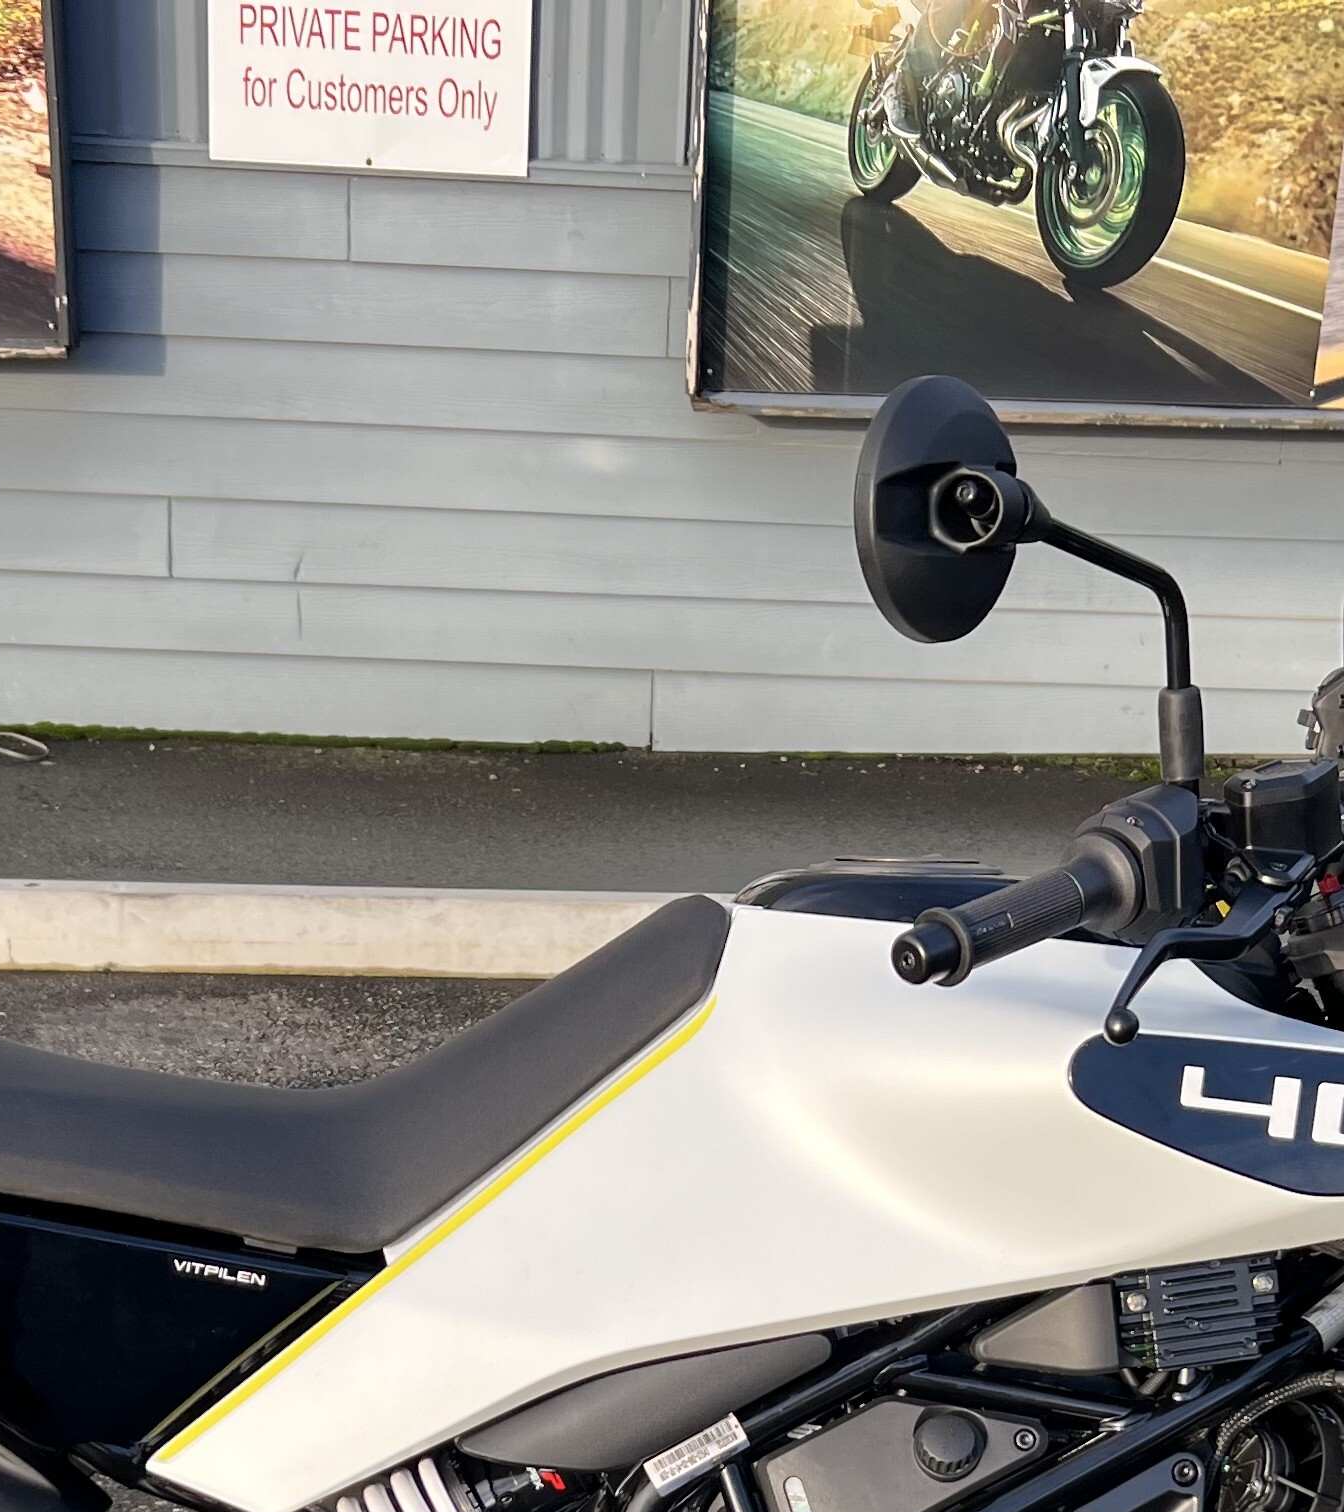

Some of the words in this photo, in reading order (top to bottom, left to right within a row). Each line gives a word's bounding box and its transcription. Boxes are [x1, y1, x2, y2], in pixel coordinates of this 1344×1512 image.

[238, 4, 361, 52] PRIVATE
[371, 11, 502, 60] PARKING
[242, 65, 277, 107] for
[286, 68, 428, 119] Customers
[438, 77, 498, 131] Only
[173, 1257, 266, 1287] VITPILEN
